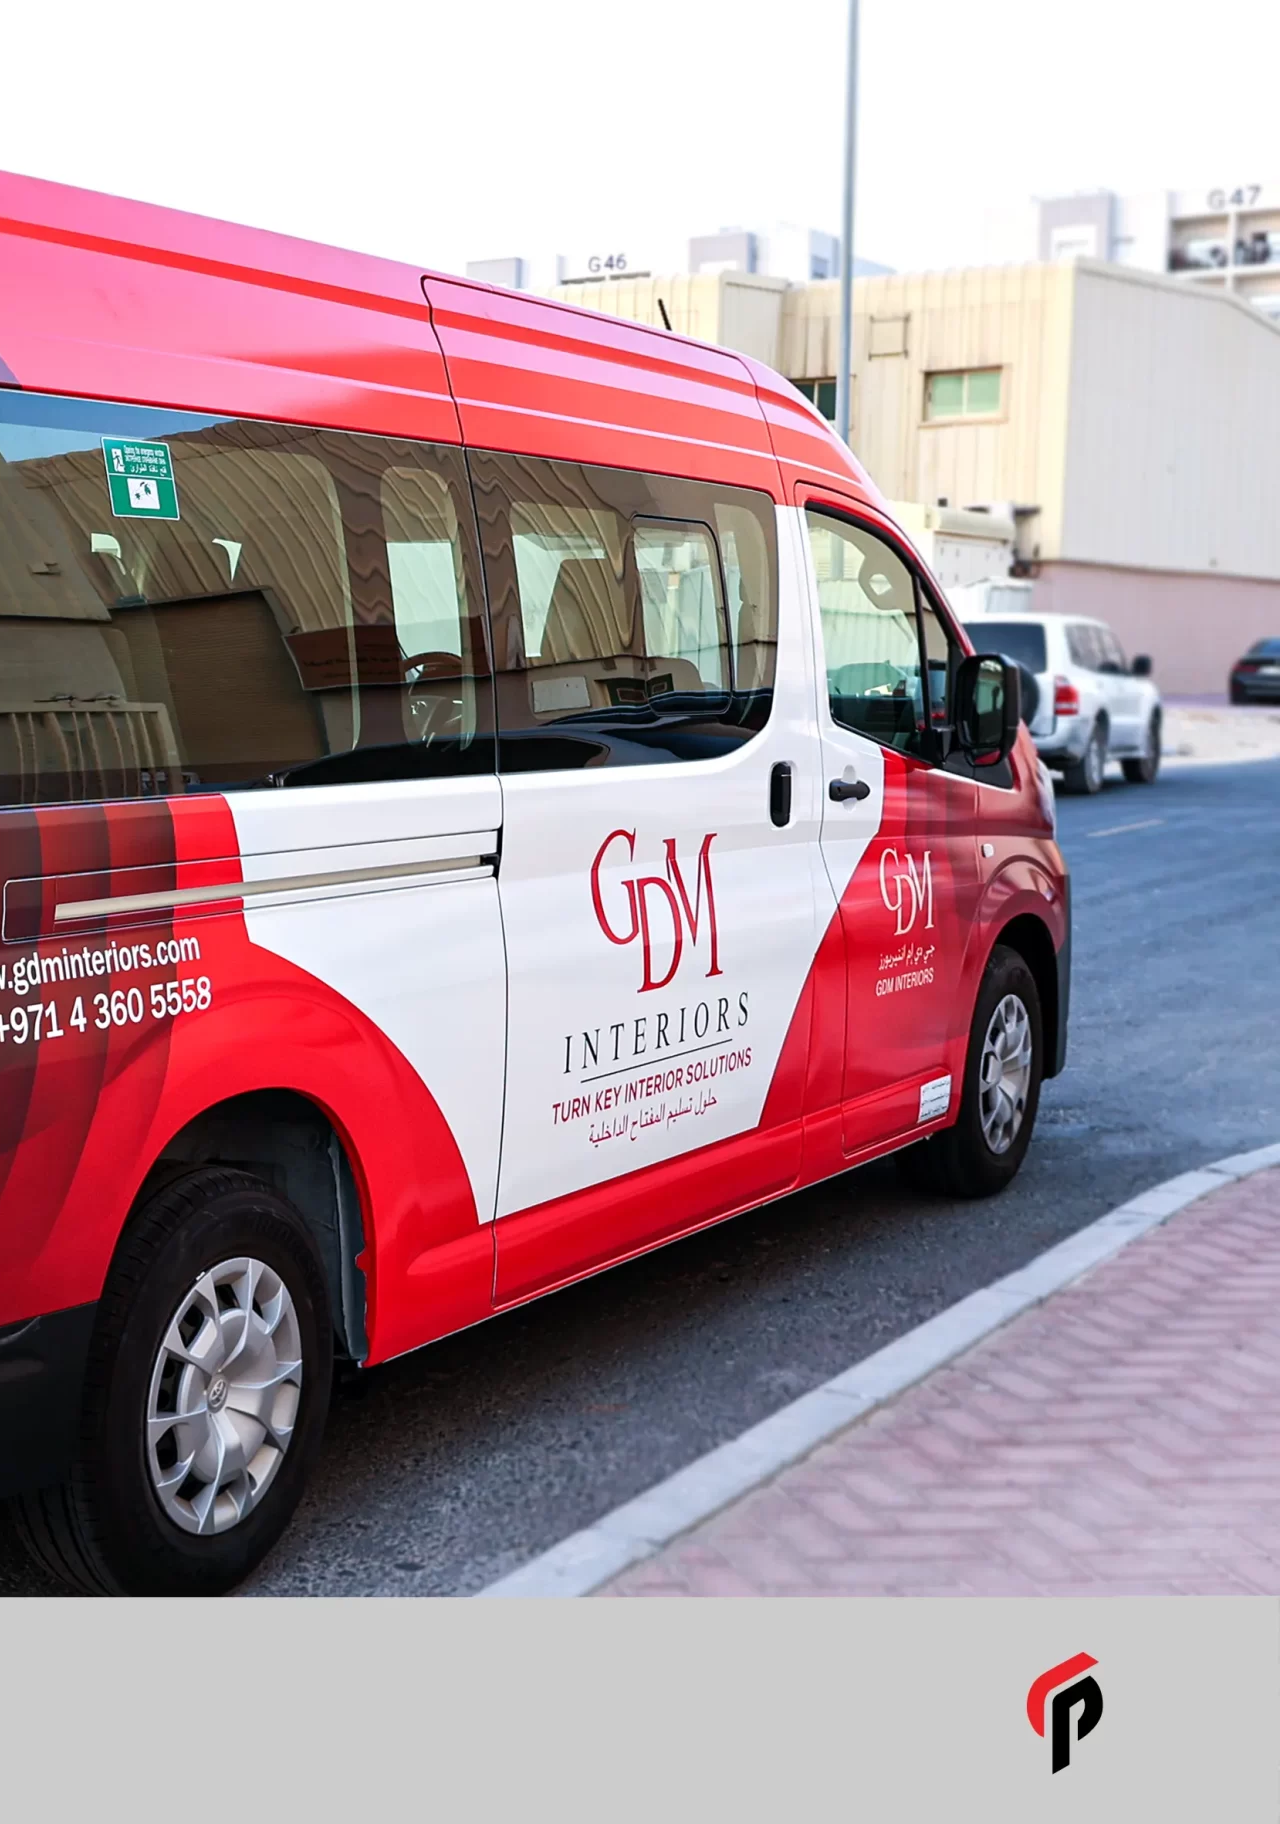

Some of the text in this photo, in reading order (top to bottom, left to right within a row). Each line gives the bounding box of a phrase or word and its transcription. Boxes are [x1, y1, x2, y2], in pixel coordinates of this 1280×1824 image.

[590, 828, 723, 993] GDM
[879, 846, 935, 936] GDM
[70, 996, 87, 1033] 4
[93, 987, 144, 1030] 360
[150, 976, 212, 1020] 5558
[894, 967, 934, 992] INTERIORS
[563, 991, 749, 1075] INTERIORS
[552, 1047, 752, 1125] TURN KEY INTERIOR SOLUTIONS
[589, 1114, 628, 1148] الداخلية
